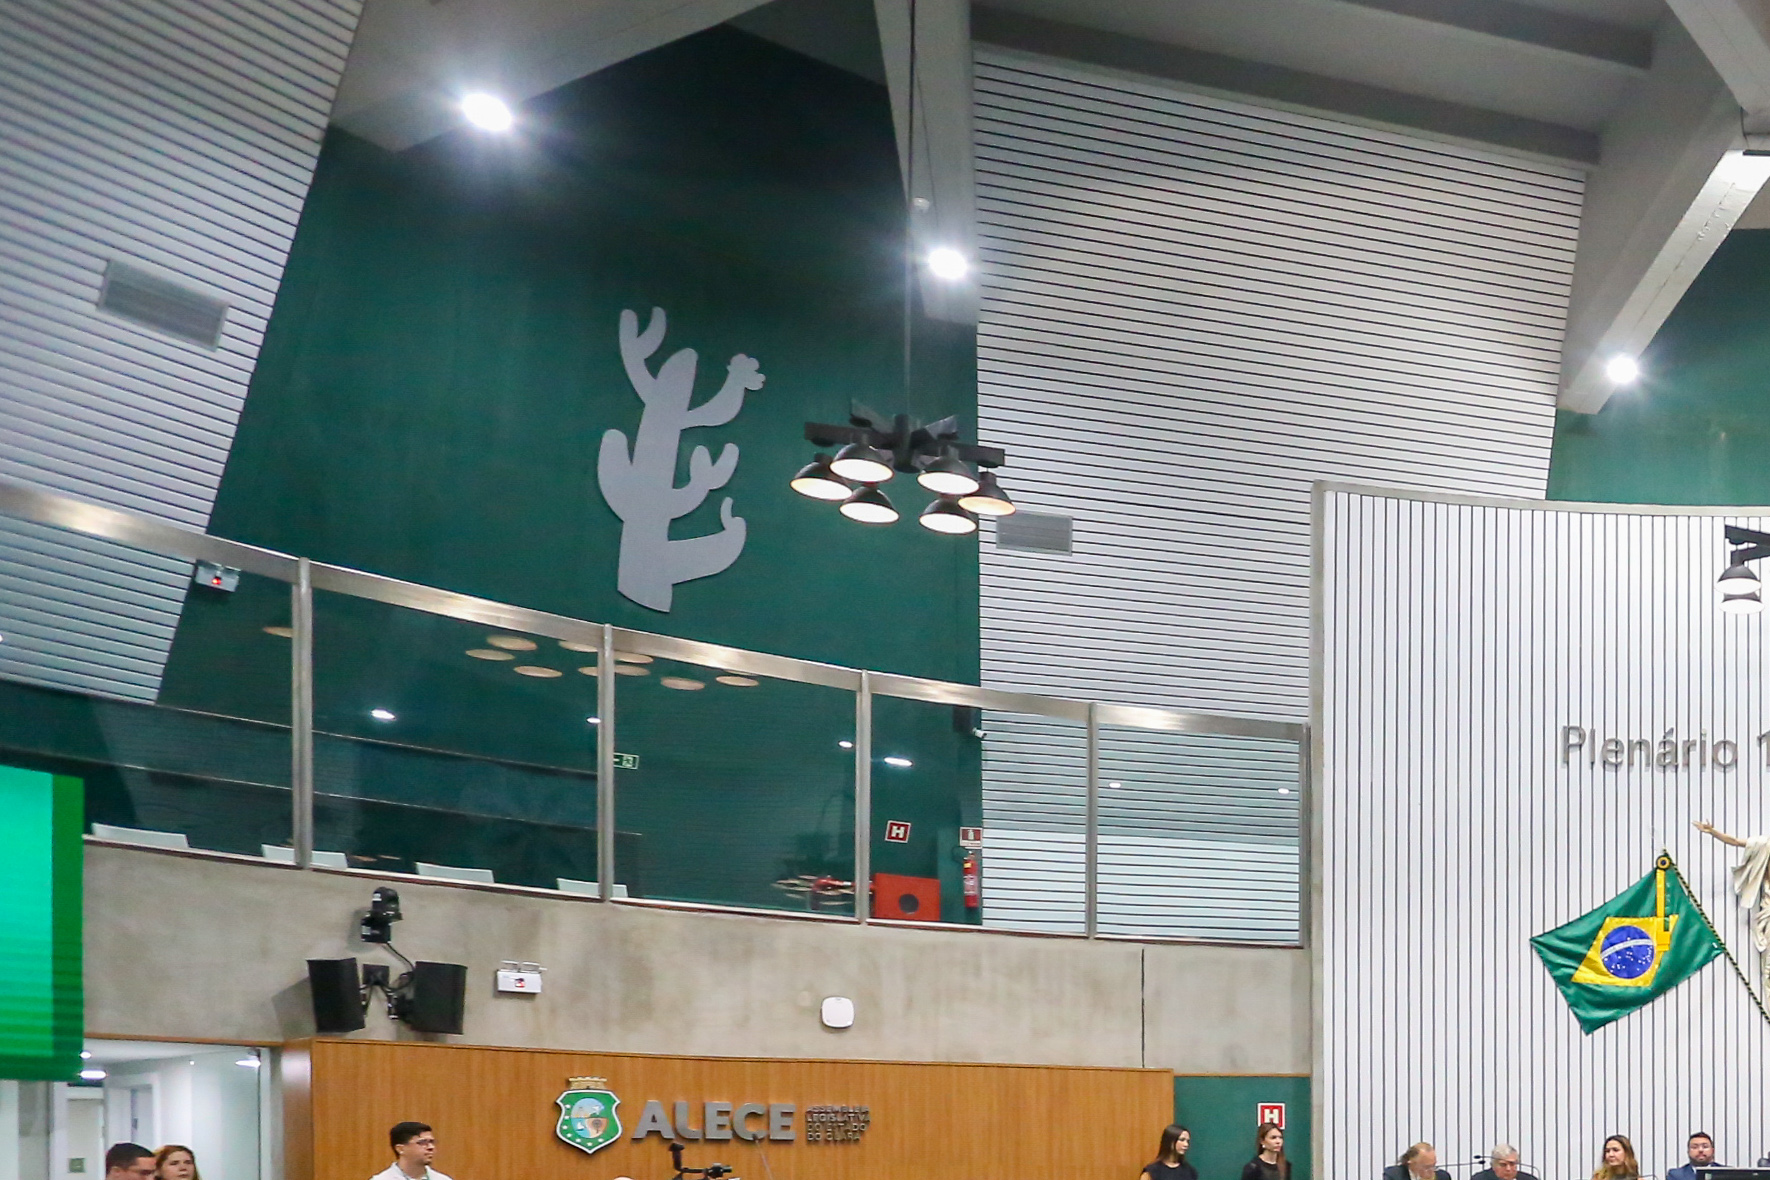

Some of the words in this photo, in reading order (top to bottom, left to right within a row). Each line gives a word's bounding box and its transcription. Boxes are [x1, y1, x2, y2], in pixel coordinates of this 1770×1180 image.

[1560, 725, 1739, 768] Plenário
[631, 1099, 797, 1142] ALECE
[1264, 1108, 1280, 1123] H
